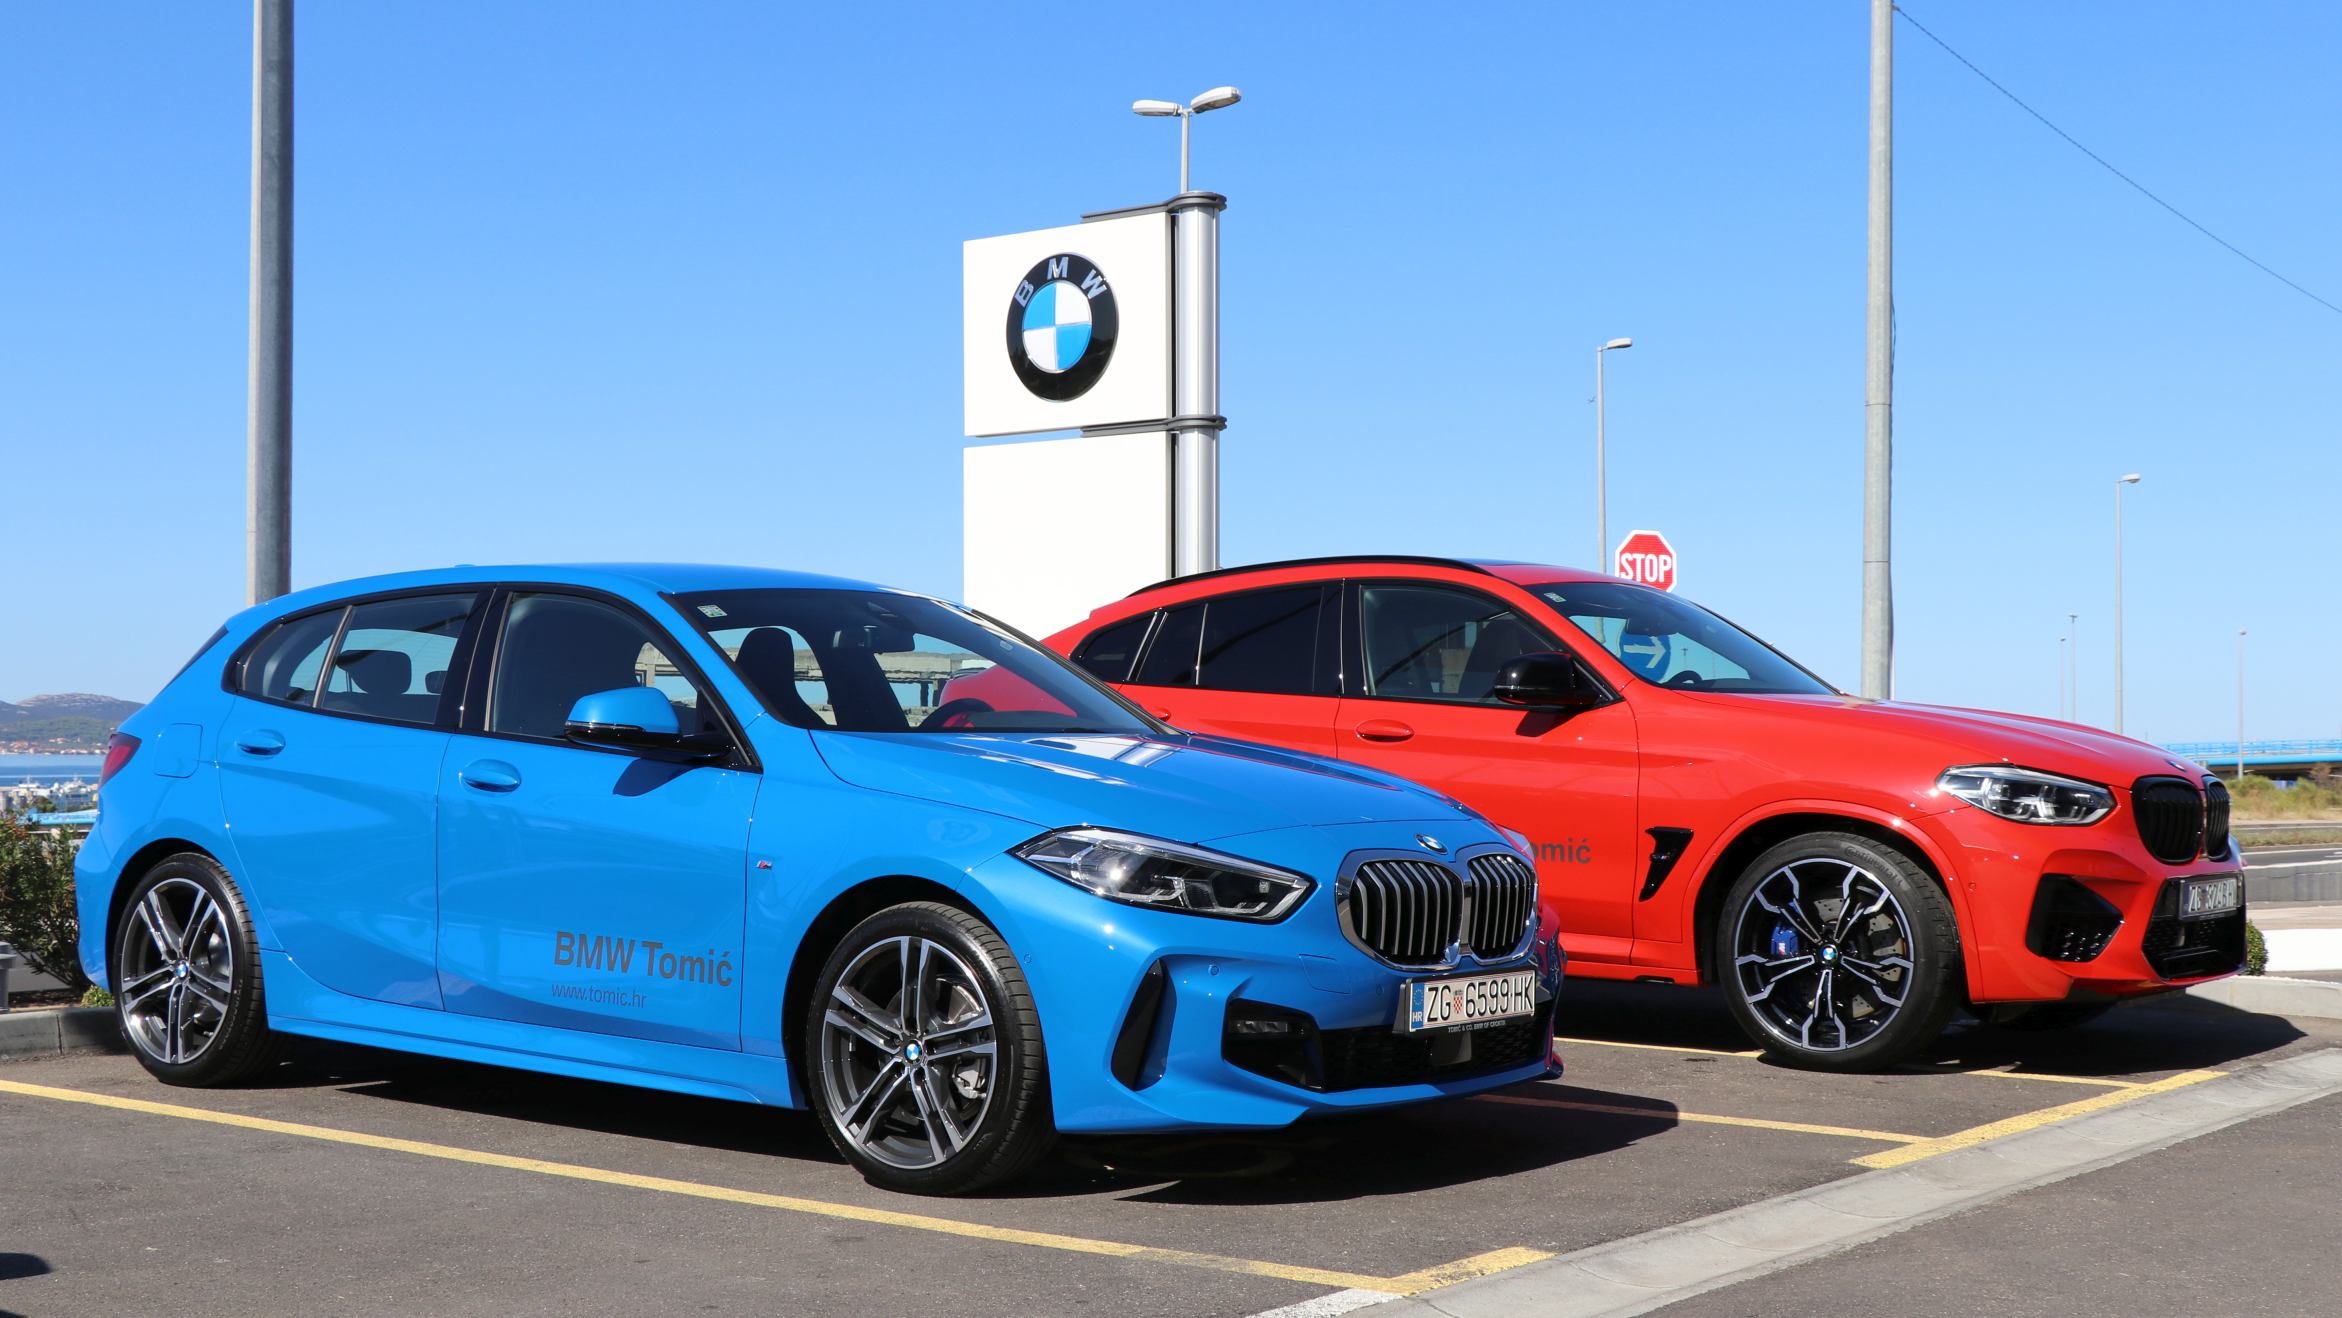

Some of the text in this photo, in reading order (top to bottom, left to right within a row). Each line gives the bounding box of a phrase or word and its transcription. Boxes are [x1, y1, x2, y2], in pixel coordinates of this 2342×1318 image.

[1014, 256, 1107, 308] BMW
[1620, 552, 1672, 583] STOP
[554, 931, 733, 987] BMW Tomić
[551, 983, 647, 1008] www.tomic.hr
[1427, 984, 1451, 1022] ZG
[1412, 1011, 1423, 1022] HR
